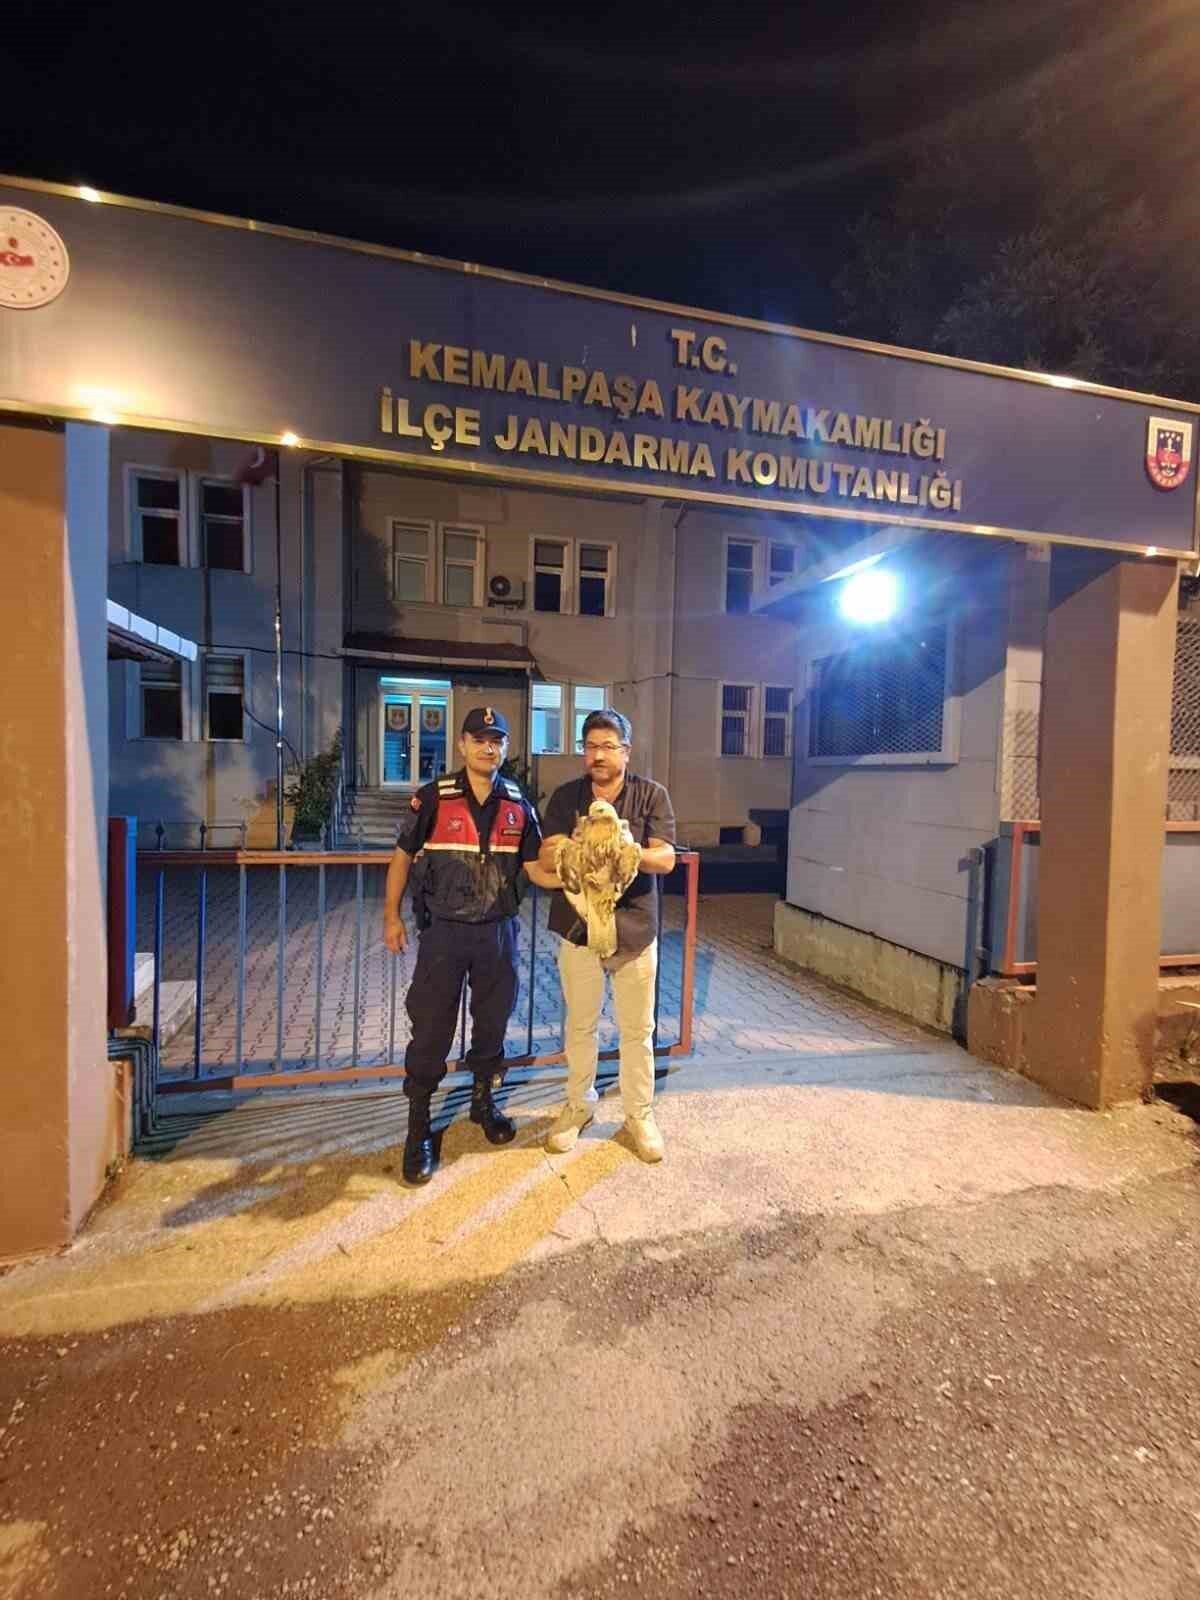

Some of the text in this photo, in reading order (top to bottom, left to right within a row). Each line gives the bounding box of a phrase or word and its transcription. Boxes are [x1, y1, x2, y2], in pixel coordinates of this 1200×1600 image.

[409, 339, 947, 460] KEMALPAŞA KAYMAKAMLIĞI
[670, 328, 738, 376] T.C.
[380, 387, 962, 511] İLÇE JANDARMA KOMUTANLIĞI
